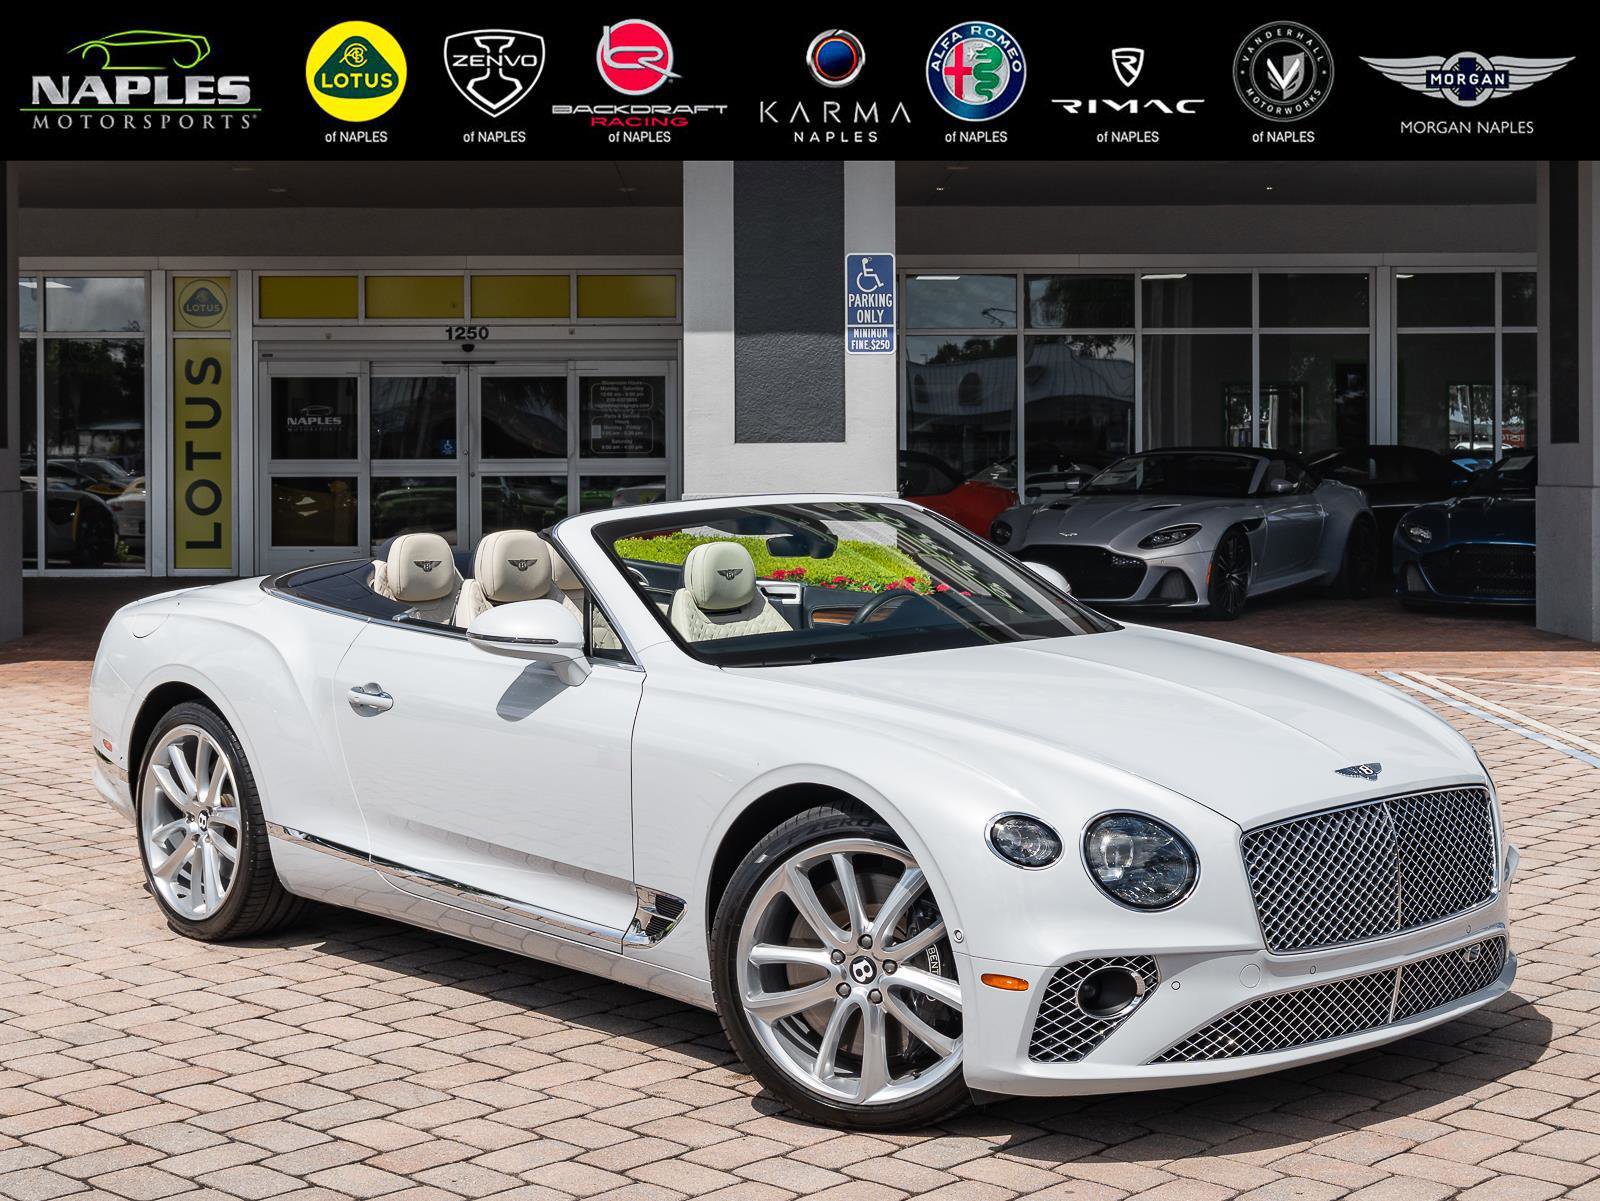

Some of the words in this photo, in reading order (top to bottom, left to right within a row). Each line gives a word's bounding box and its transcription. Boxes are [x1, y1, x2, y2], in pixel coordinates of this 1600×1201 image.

[848, 293, 893, 308] PARKING
[186, 303, 222, 313] LOTUS
[856, 309, 884, 323] ONLY
[445, 326, 490, 341] 1250
[853, 328, 888, 338] MINIMUM
[851, 339, 870, 350] FINE
[871, 339, 891, 351] $250
[286, 416, 342, 425] NAPLES
[185, 356, 222, 550] LOTUS
[929, 946, 941, 976] BENT
